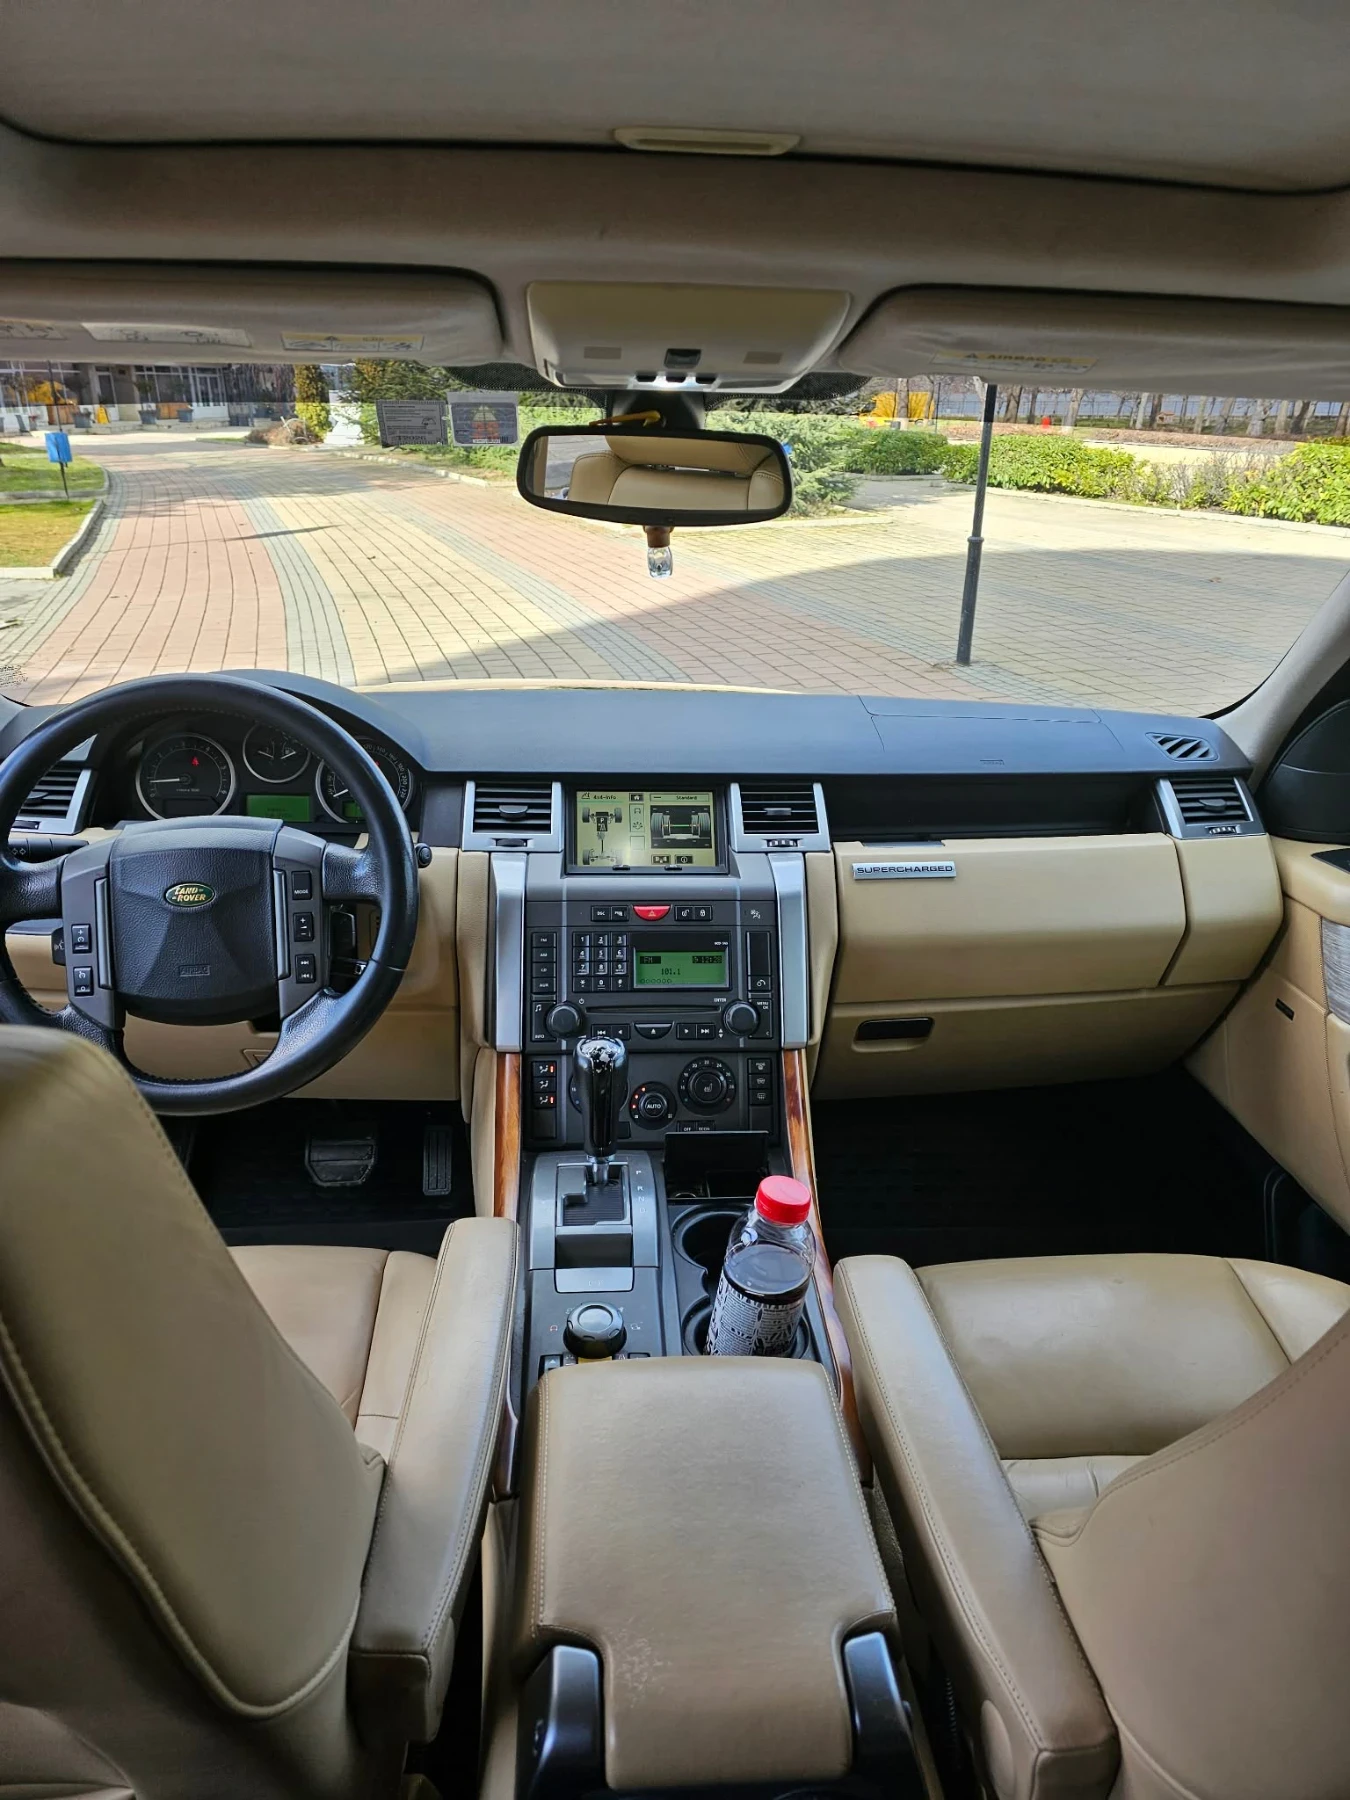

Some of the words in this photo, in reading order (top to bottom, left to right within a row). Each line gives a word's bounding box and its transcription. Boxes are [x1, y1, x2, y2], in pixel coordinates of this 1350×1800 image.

[856, 865, 953, 874] SUPERCHARGED
[175, 887, 198, 895] LAND
[177, 893, 206, 902] ROVER
